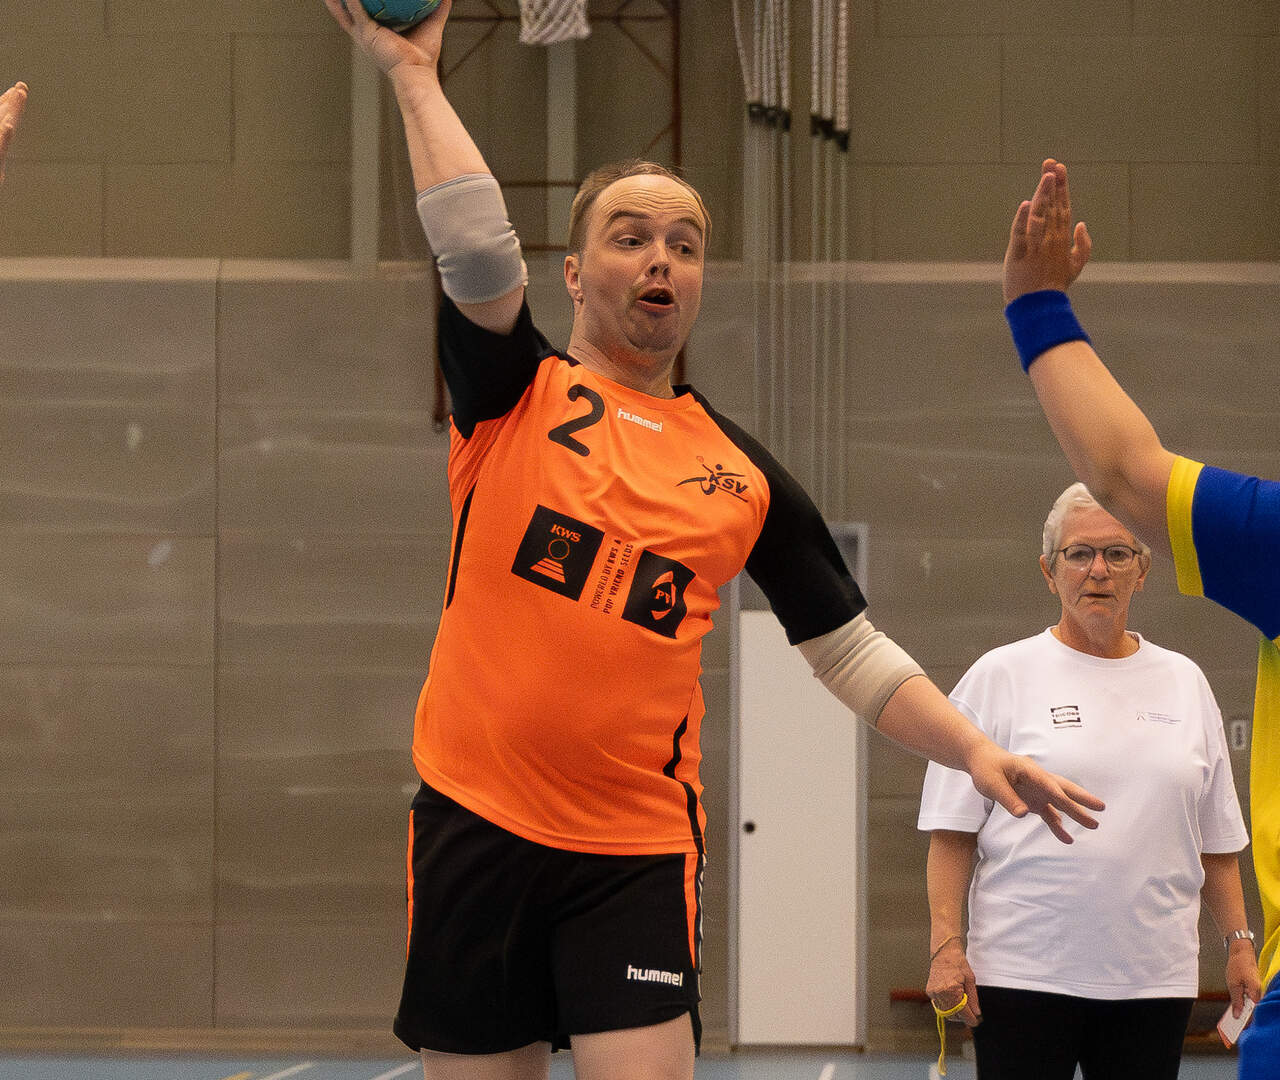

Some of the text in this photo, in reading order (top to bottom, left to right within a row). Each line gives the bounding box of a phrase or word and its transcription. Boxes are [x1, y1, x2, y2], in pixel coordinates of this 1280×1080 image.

[547, 384, 605, 457] 2
[616, 408, 663, 433] hummel
[550, 523, 582, 543] KWS
[626, 964, 683, 987] hummel
